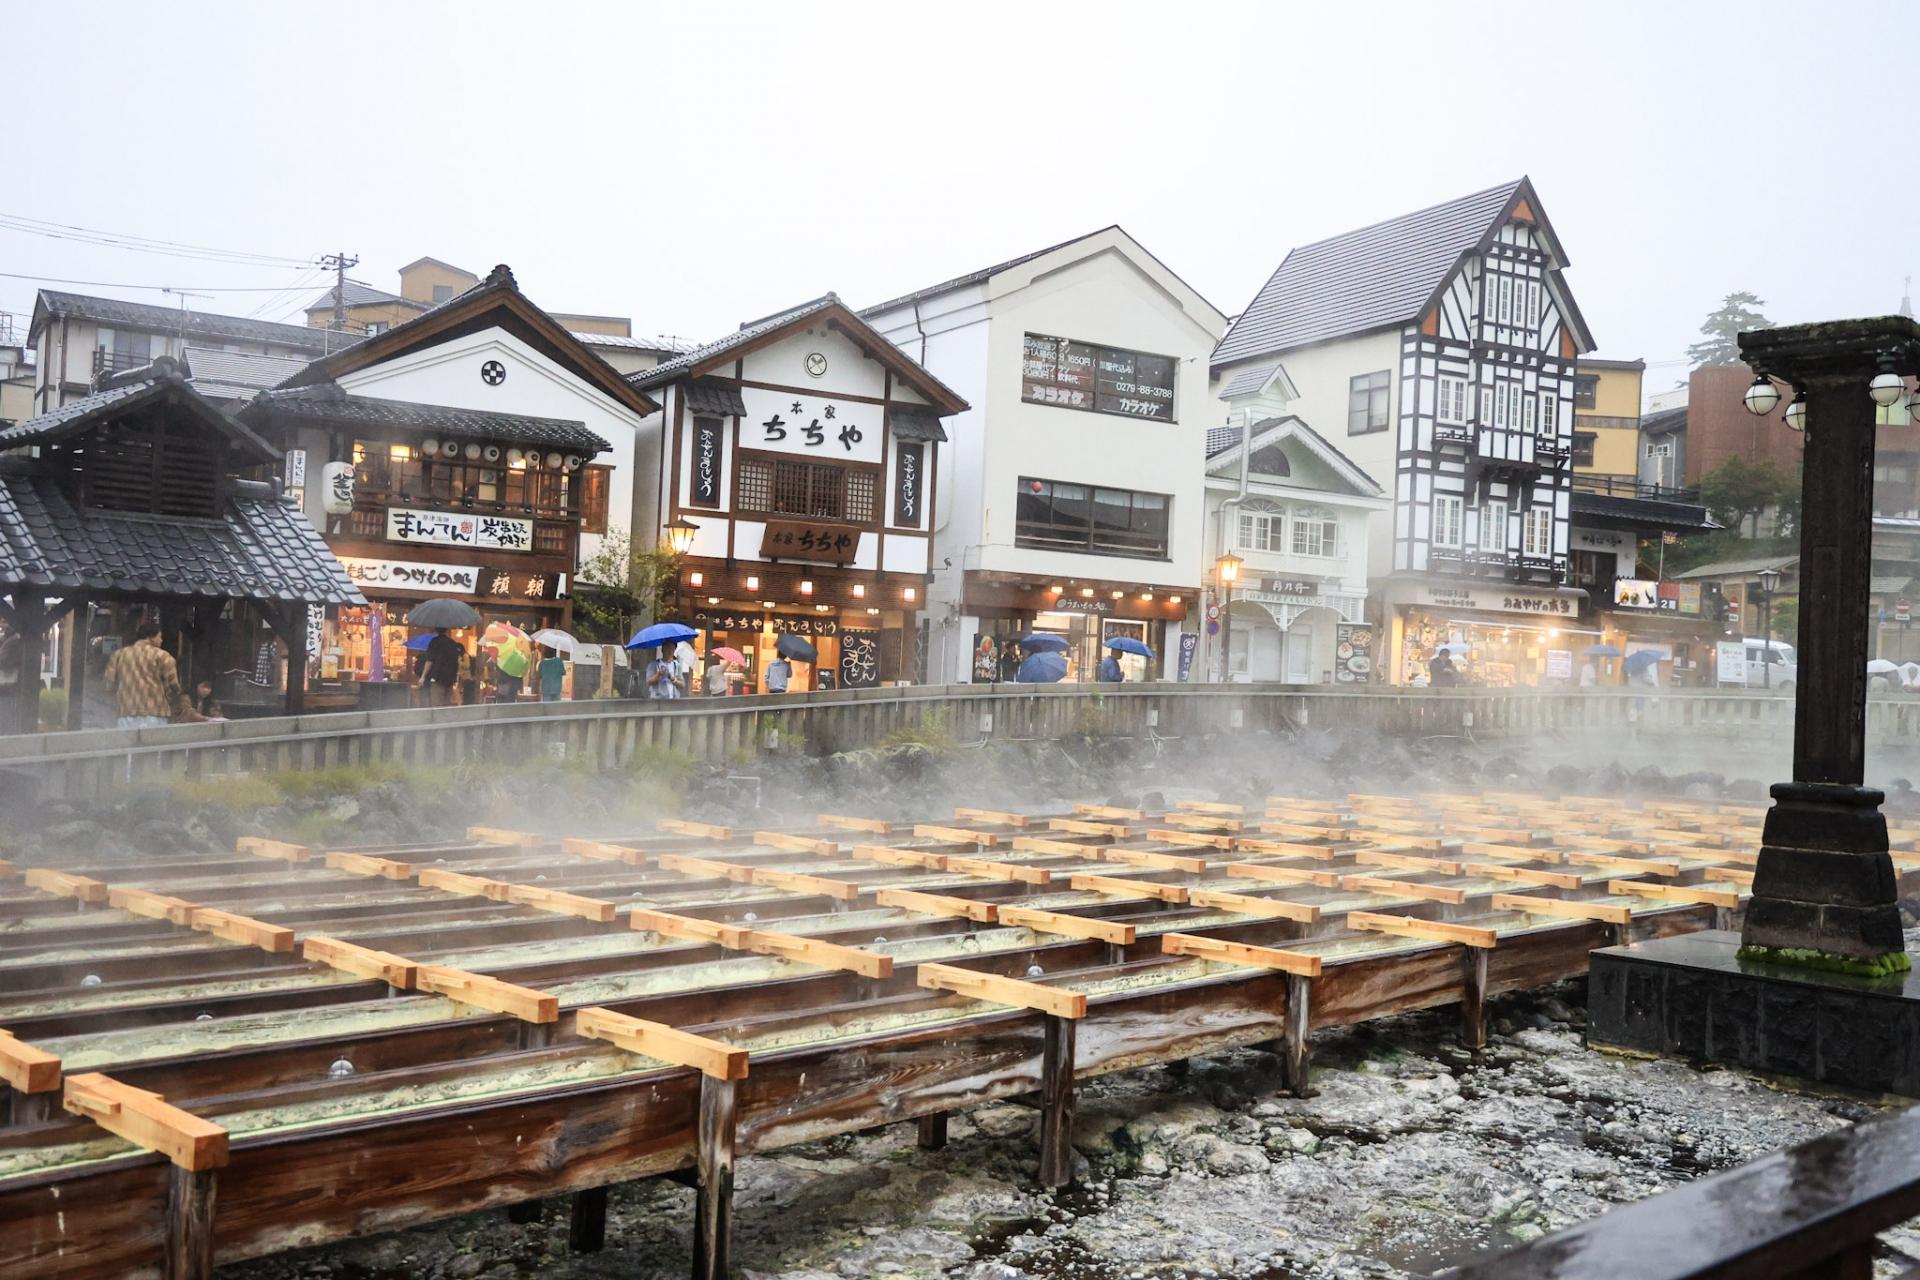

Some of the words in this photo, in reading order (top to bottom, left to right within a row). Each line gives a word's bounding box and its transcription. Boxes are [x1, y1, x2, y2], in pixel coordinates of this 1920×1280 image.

[1032, 386, 1085, 405] カラオケ
[1116, 382, 1173, 399] 0279-88-3788
[790, 400, 837, 419] 本家
[1119, 398, 1160, 416] カラオケ
[761, 414, 864, 451] ちちや
[393, 511, 470, 542] まんてん
[797, 529, 852, 554] ちちや
[723, 616, 763, 630] ちちや
